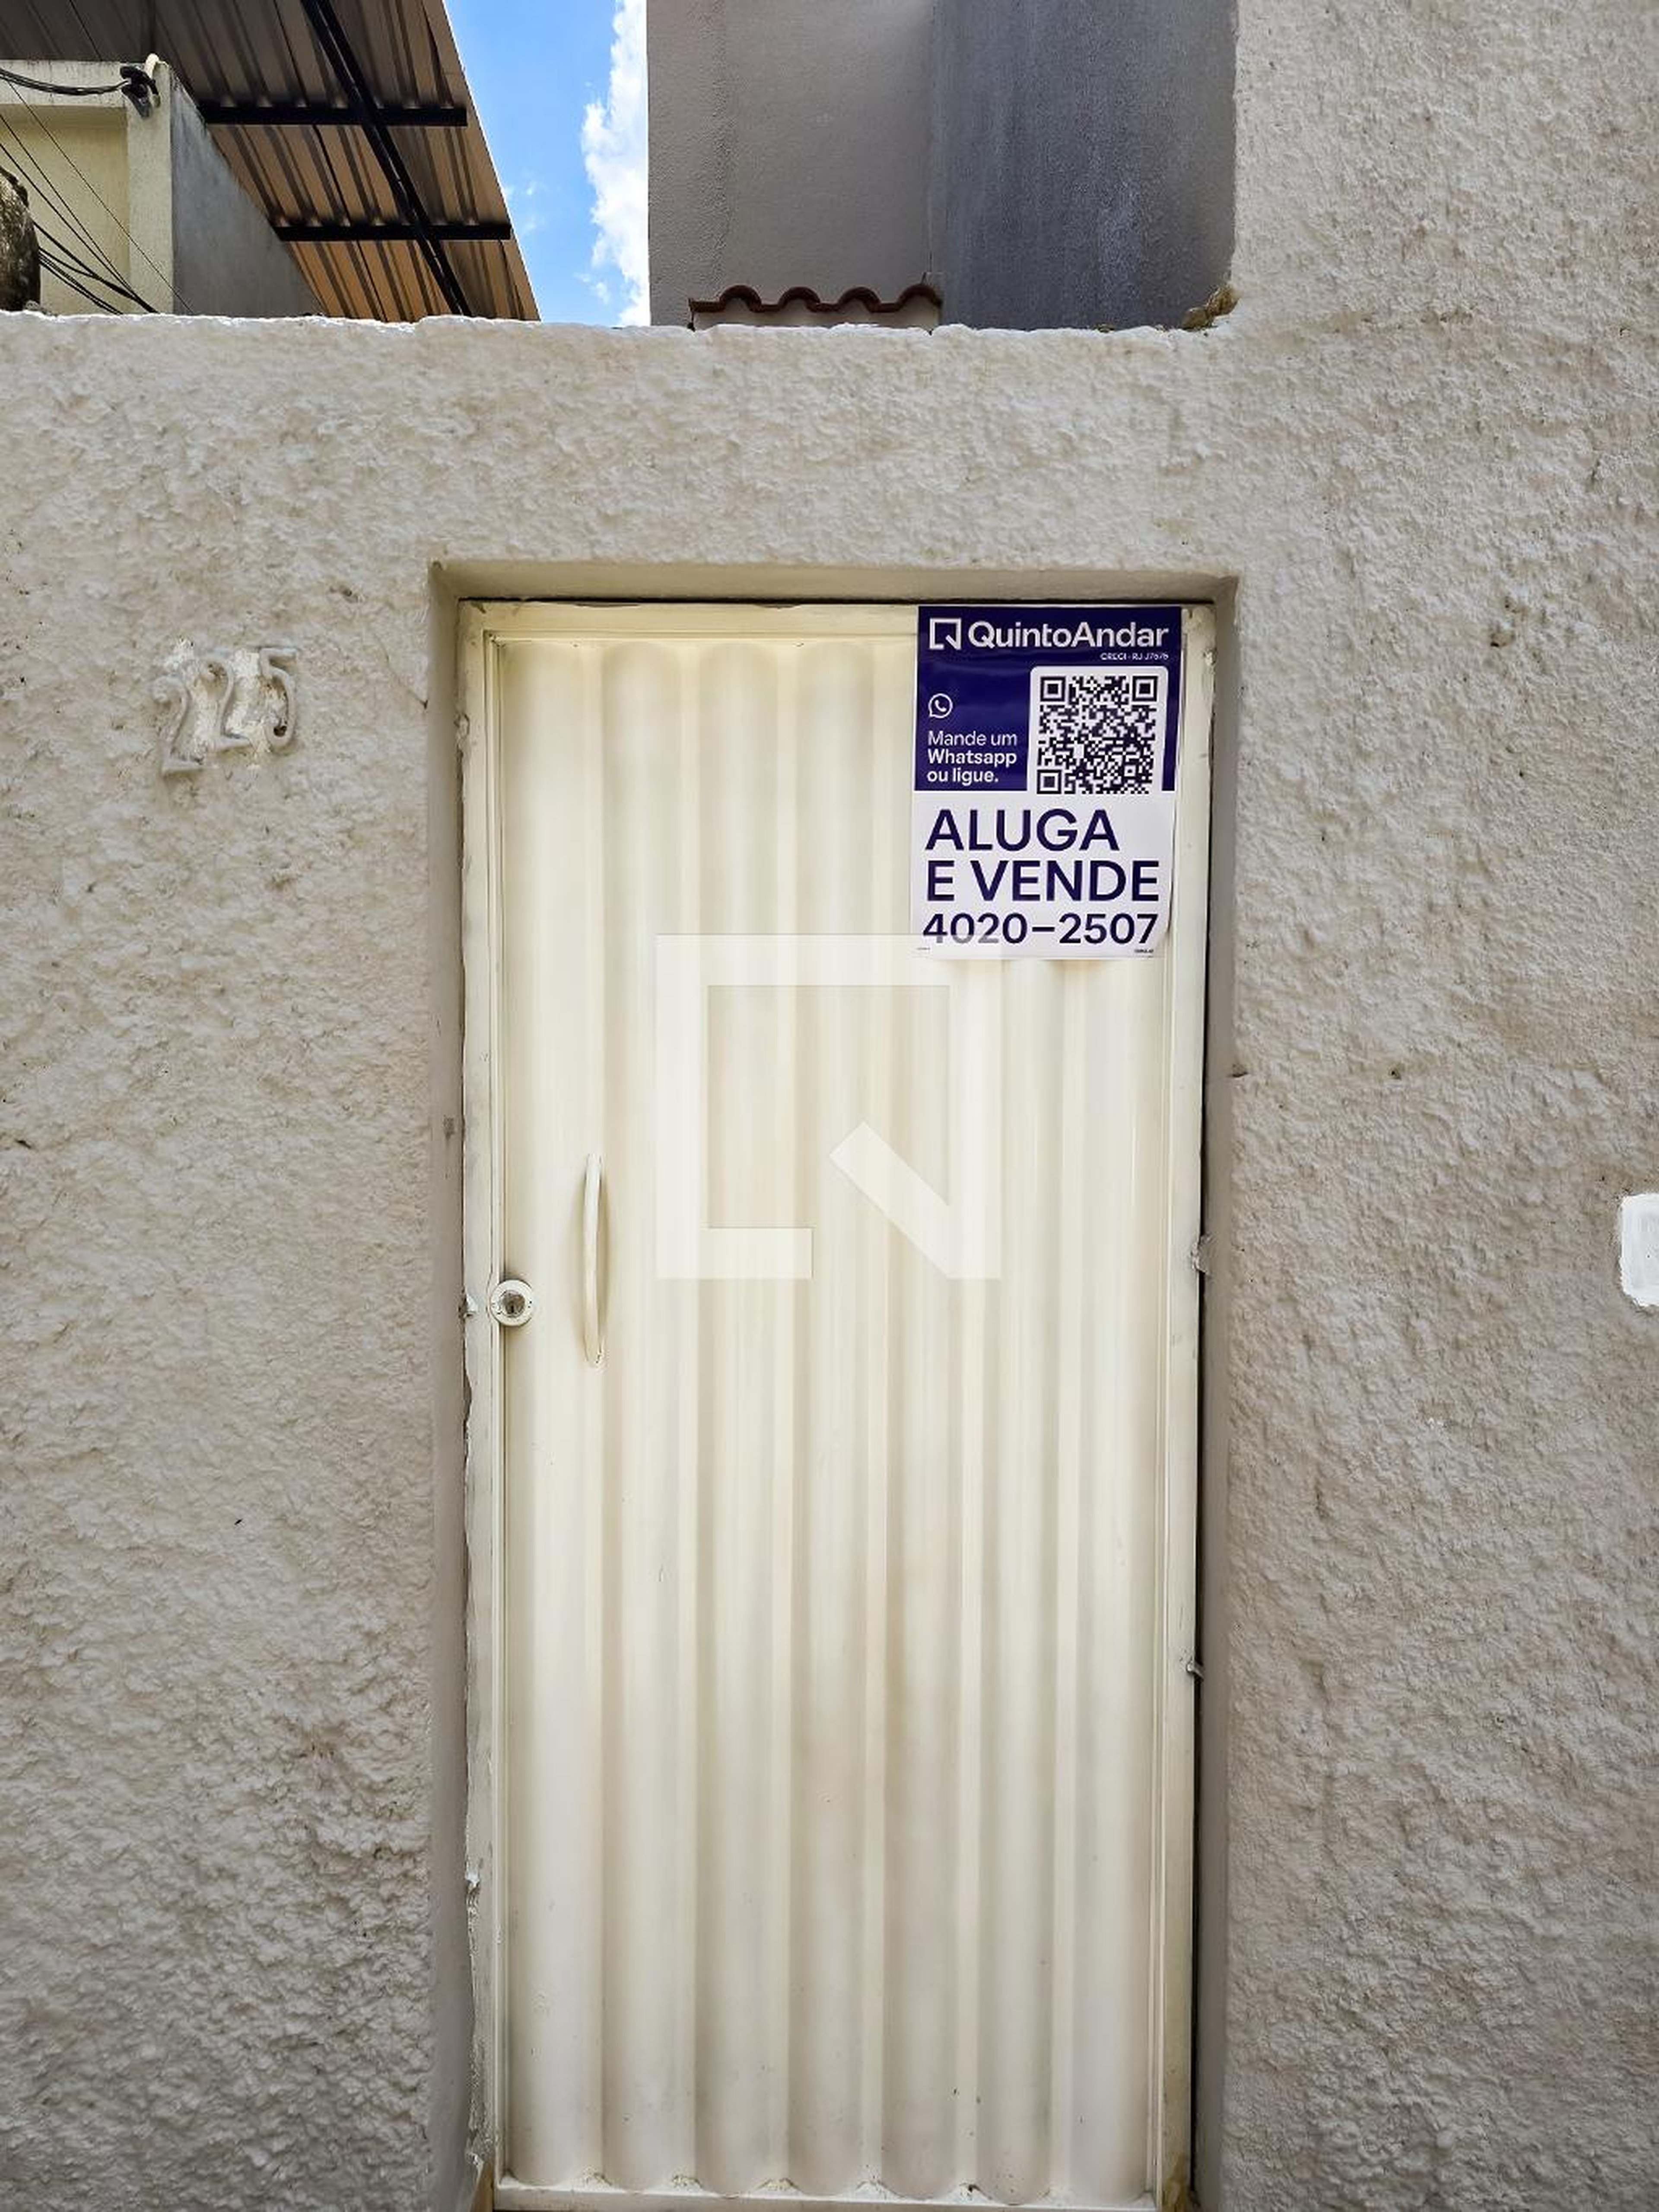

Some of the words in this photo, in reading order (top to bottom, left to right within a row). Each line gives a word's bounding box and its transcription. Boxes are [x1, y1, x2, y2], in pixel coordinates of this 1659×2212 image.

[968, 621, 1169, 648] QuintoAndar
[928, 731, 986, 746] Mande
[991, 734, 1017, 746] um
[928, 748, 1017, 767] Whatsapp
[927, 772, 950, 782] ou
[953, 768, 999, 786] ligue.
[925, 809, 1119, 851] ALUGA
[927, 860, 955, 901] E
[970, 860, 1159, 902] VENDE
